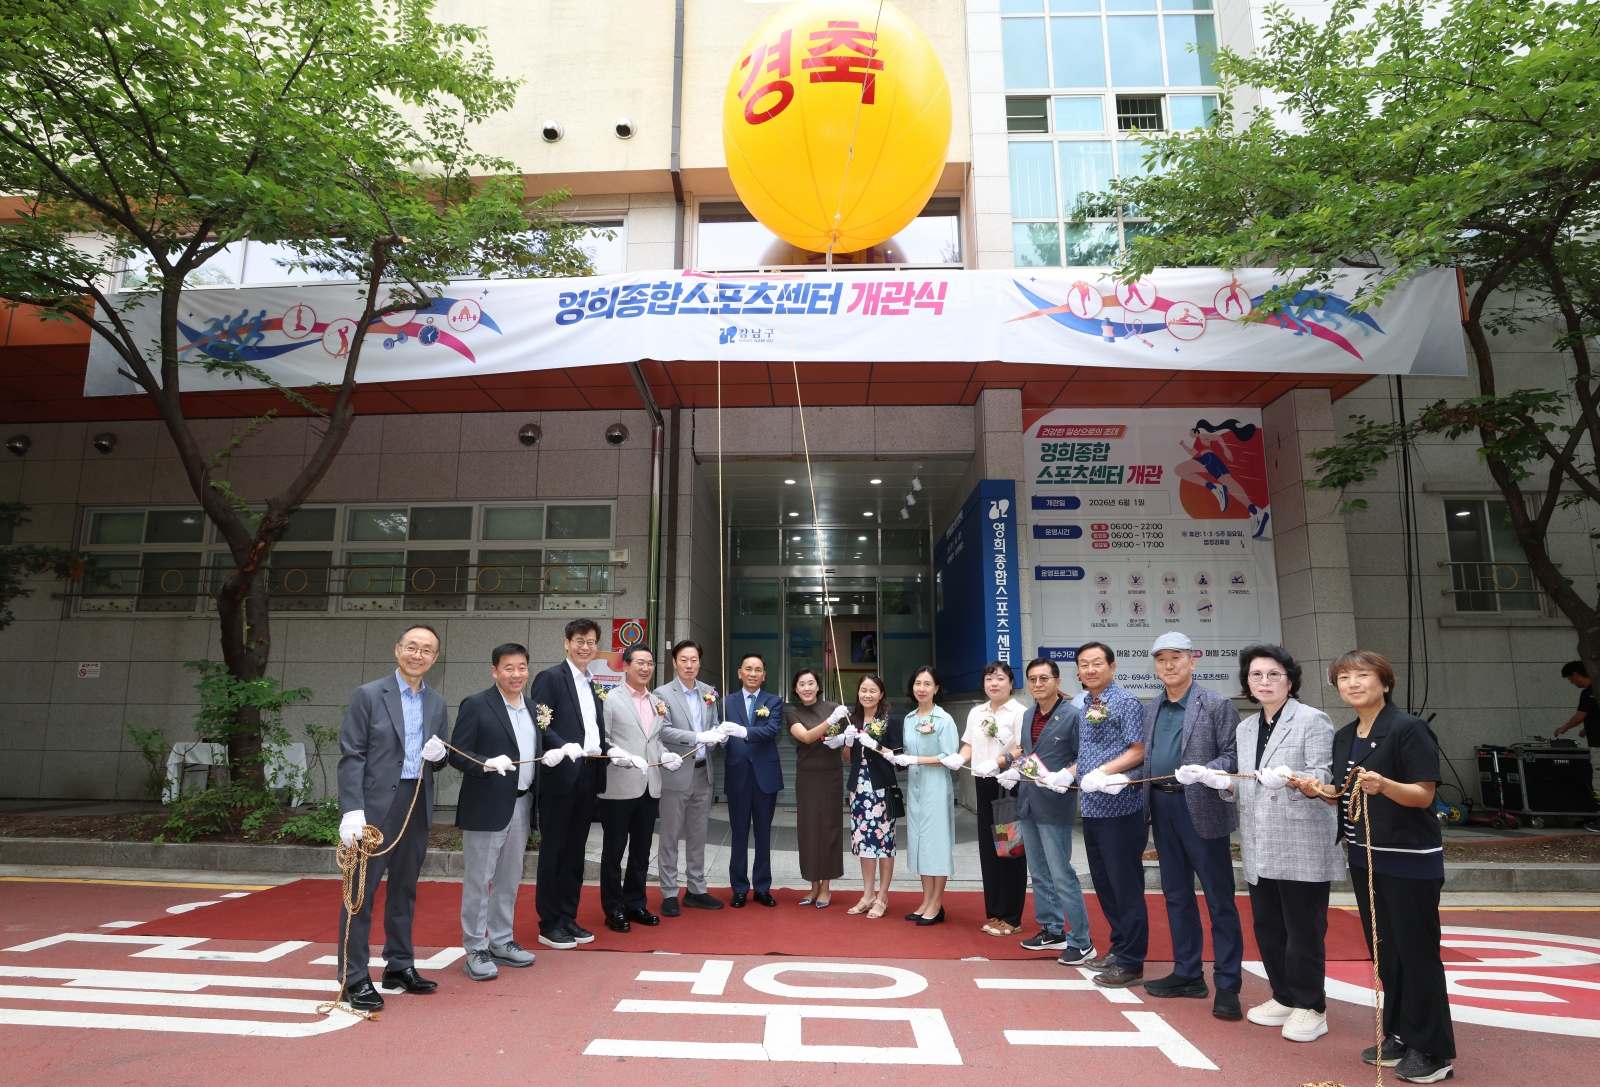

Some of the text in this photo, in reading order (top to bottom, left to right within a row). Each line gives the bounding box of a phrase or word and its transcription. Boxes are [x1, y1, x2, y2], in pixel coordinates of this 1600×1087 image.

[737, 21, 884, 125] 경축
[555, 281, 948, 325] 영희종합스포츠센터 개관식
[738, 328, 775, 338] 강남구
[1041, 428, 1119, 436] 건강한 일상으로의 초대
[1040, 442, 1110, 462] 영희종합
[1036, 465, 1163, 484] 스포츠센터 개관
[1046, 499, 1066, 507] 개관일
[1045, 528, 1070, 536] 운영시간
[1041, 569, 1078, 577] 운영프로그램
[993, 522, 1011, 666] 영희종합스포츠센터
